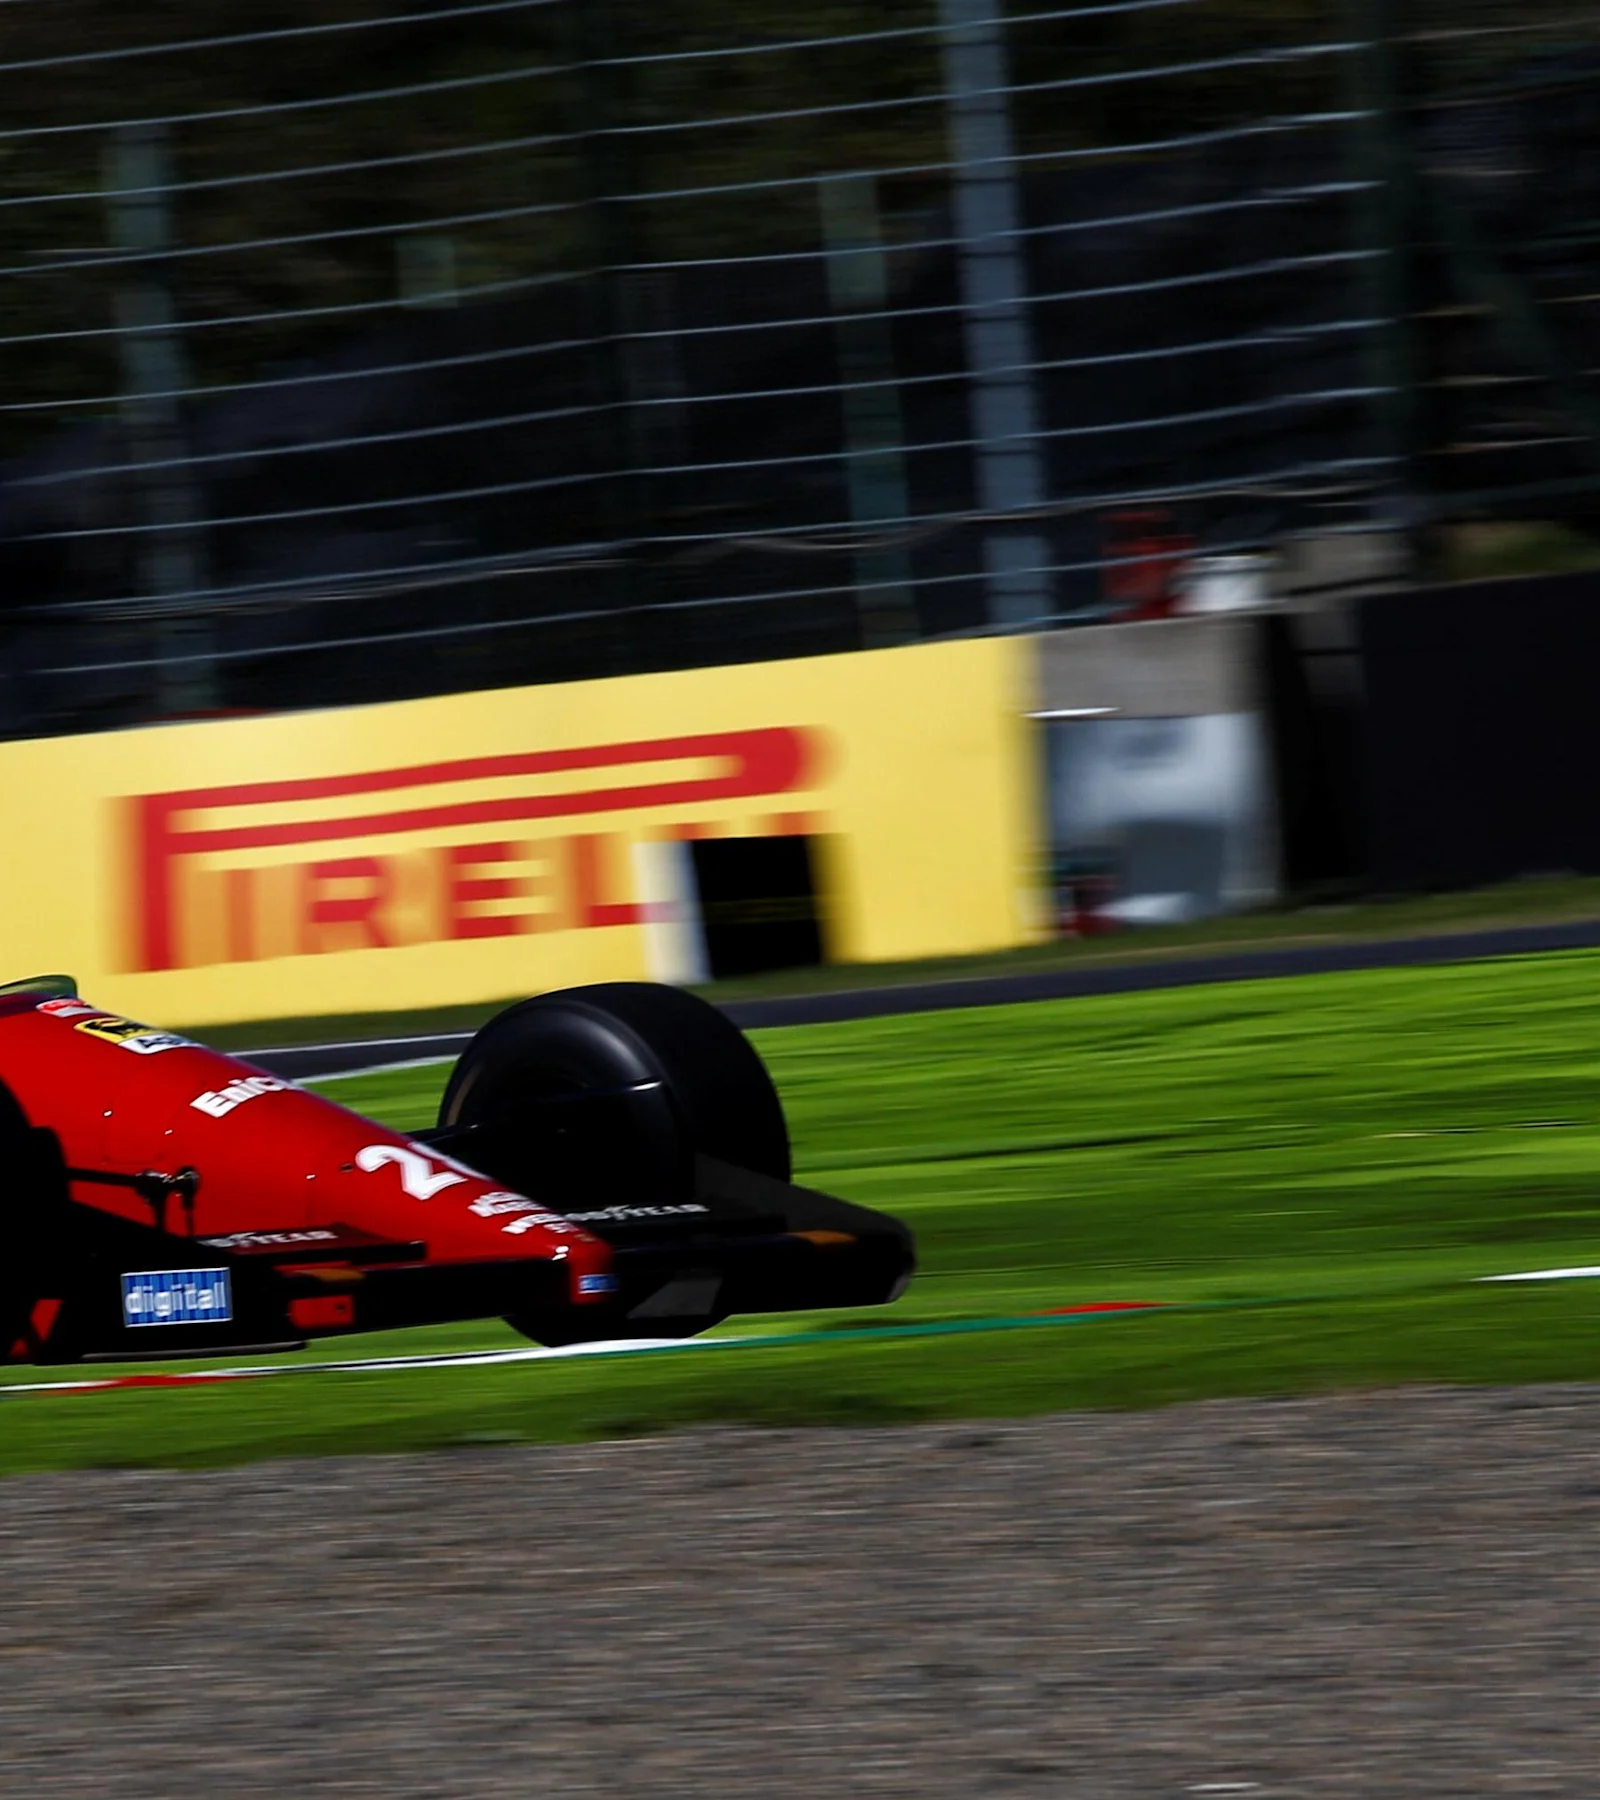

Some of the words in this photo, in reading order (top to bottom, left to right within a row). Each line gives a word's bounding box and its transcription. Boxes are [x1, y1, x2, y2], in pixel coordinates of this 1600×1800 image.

[122, 722, 836, 974] PIREL
[189, 1076, 294, 1118] Enic
[125, 1281, 226, 1317] digital
